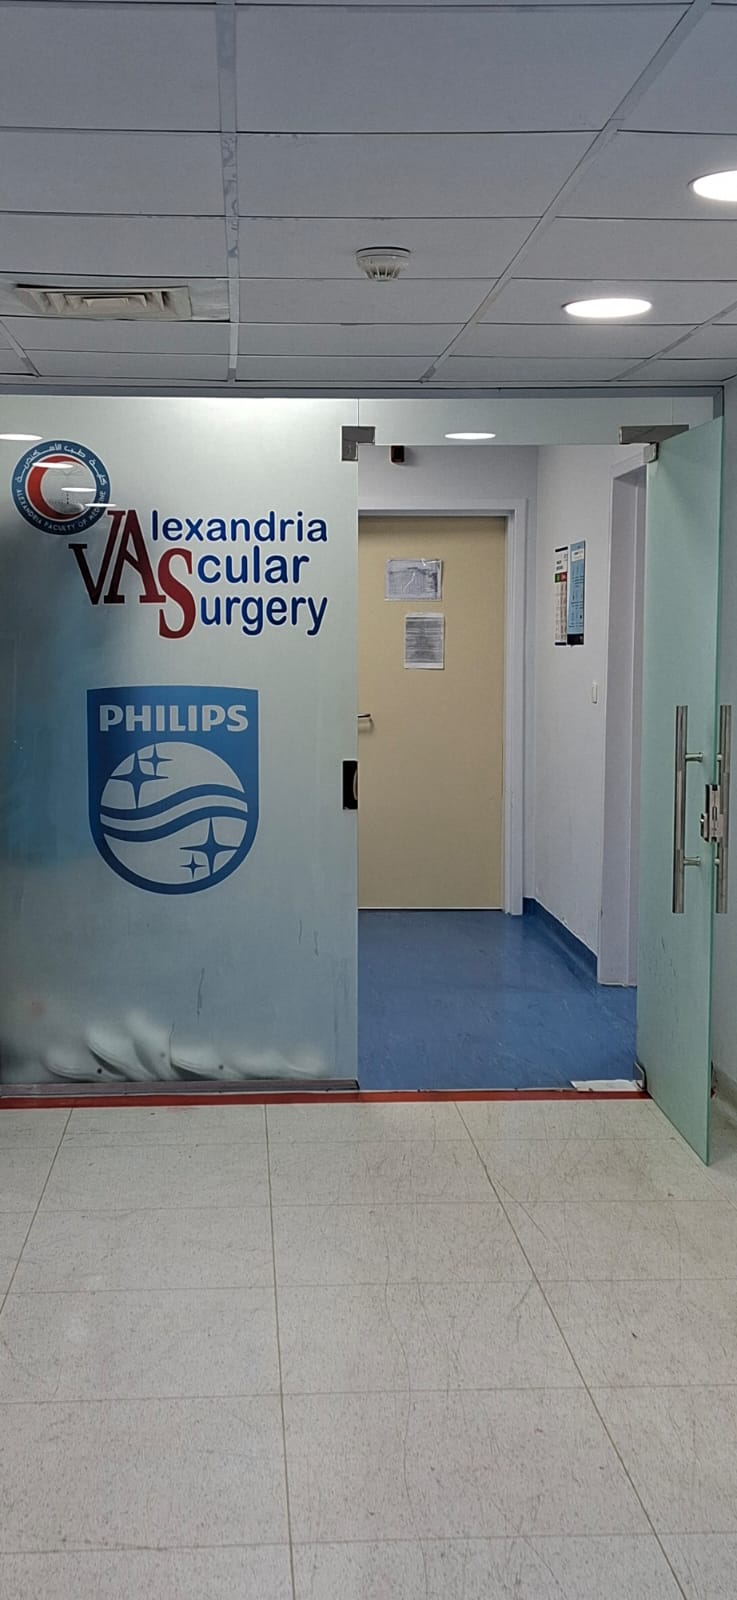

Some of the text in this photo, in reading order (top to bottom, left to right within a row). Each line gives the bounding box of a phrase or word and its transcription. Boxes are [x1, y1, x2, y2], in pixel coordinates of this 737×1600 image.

[64, 444, 86, 458] طب
[88, 458, 108, 486] كلية
[16, 489, 42, 525] ALEXANDRIA
[43, 521, 76, 532] FACULTY
[78, 518, 88, 528] OF
[99, 704, 249, 732] PHILIPS
